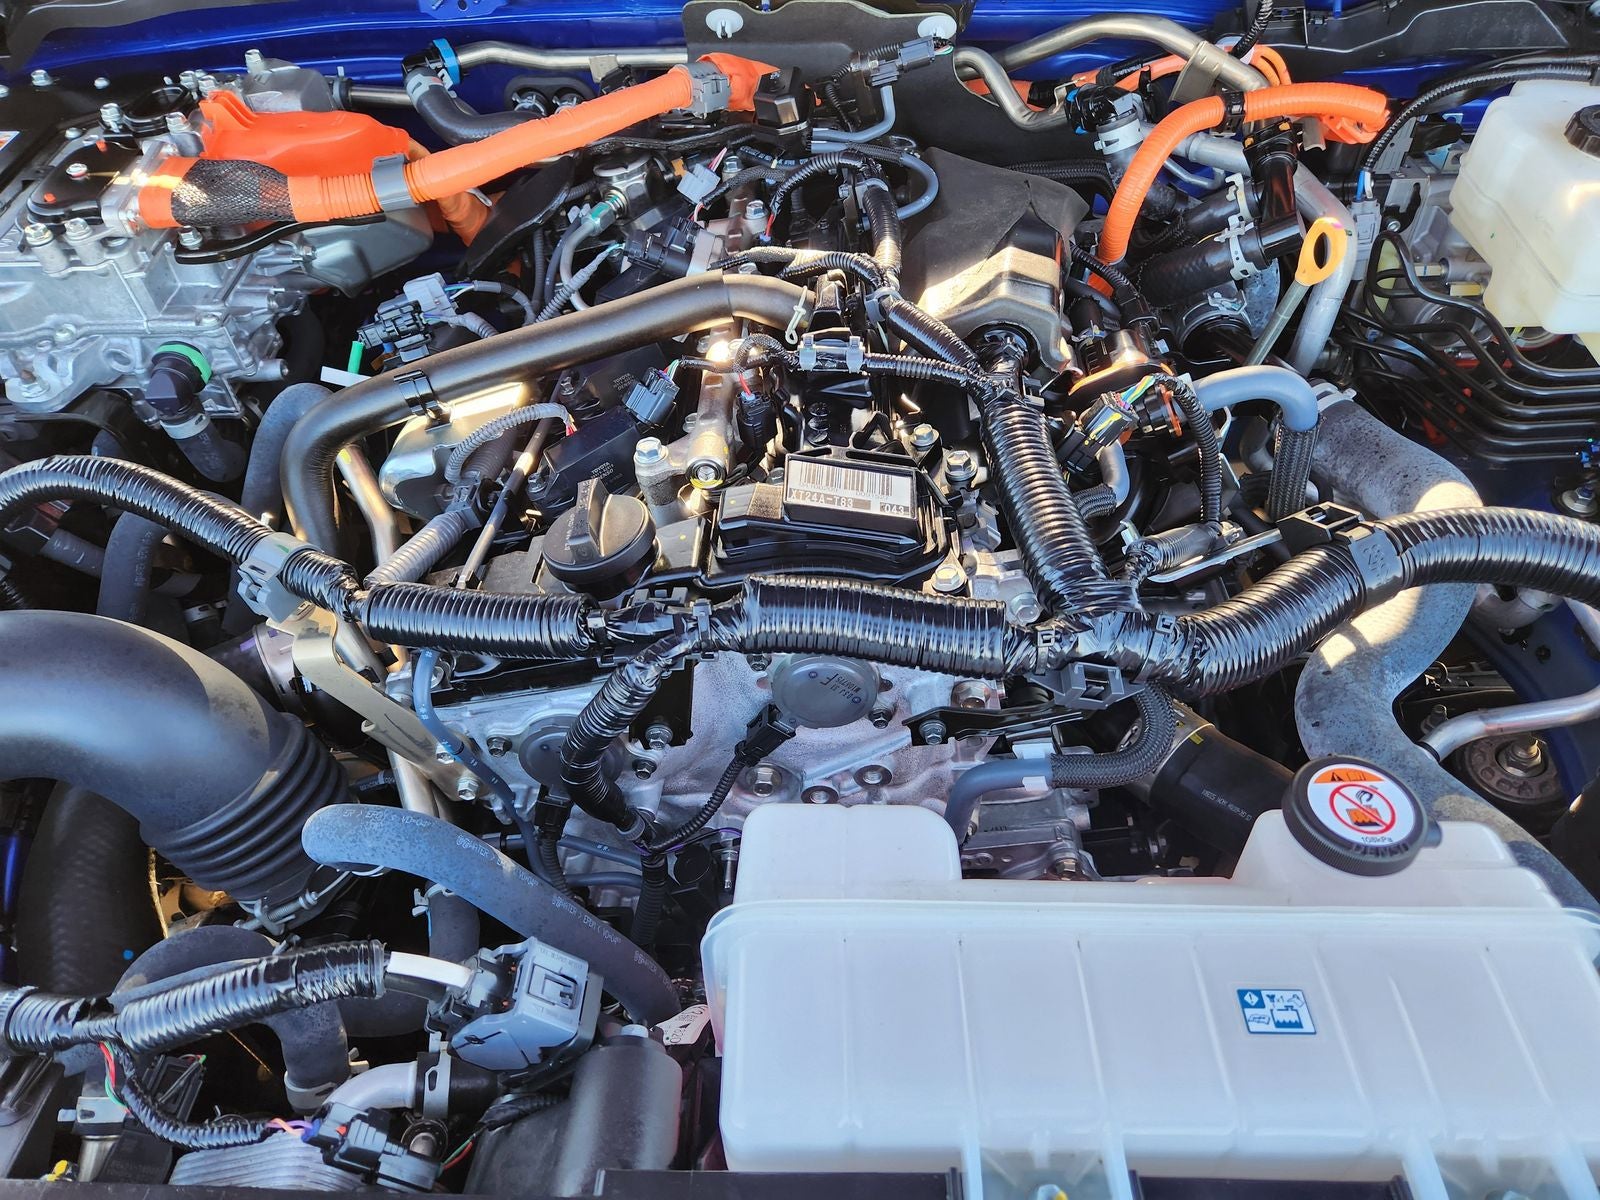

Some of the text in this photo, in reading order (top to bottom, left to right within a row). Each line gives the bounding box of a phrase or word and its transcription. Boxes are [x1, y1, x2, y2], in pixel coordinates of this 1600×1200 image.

[591, 461, 610, 474] TOYOTA
[791, 488, 853, 508] XT24A-T83
[1352, 842, 1409, 857] DENSO
